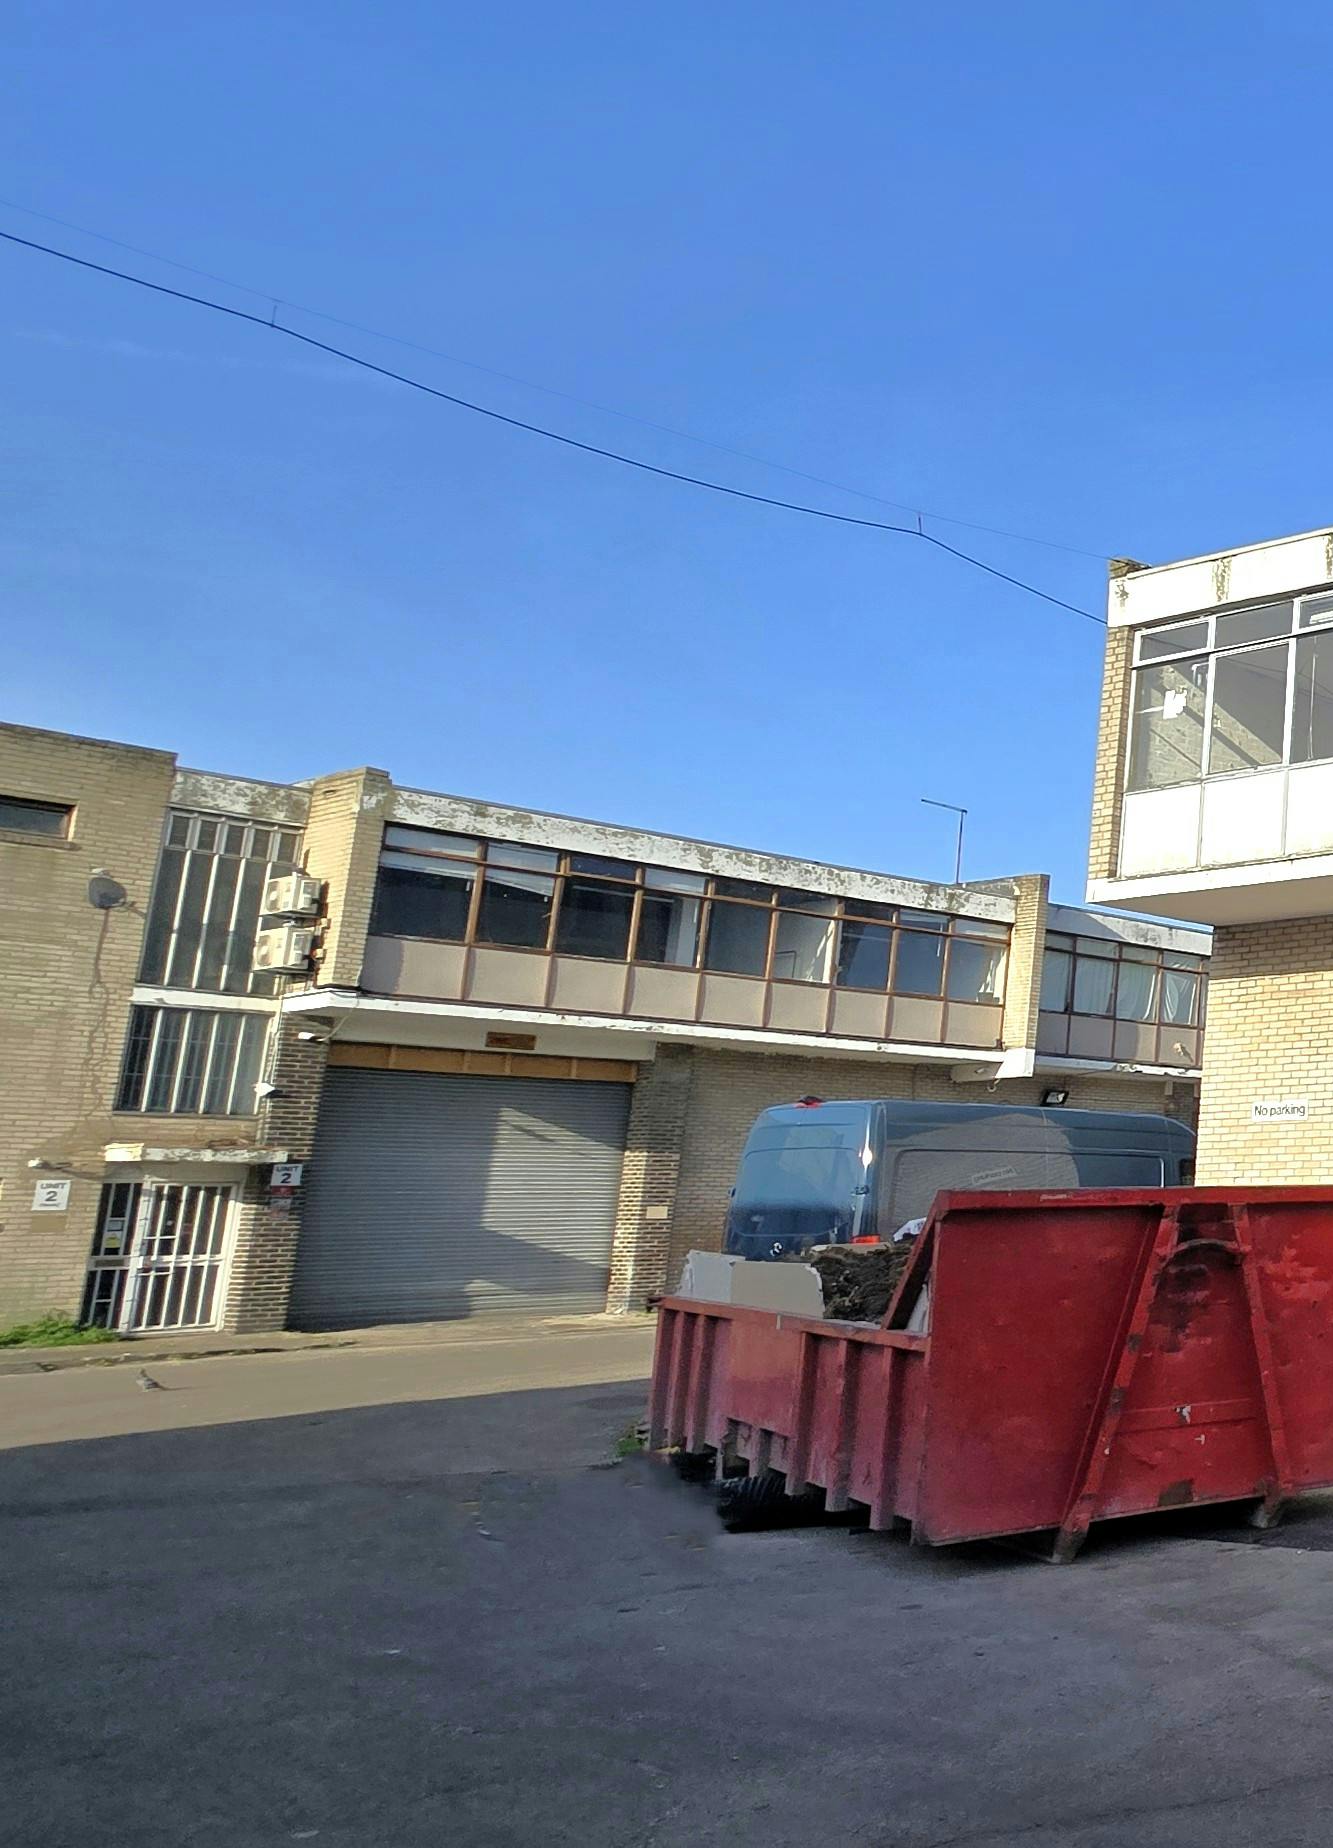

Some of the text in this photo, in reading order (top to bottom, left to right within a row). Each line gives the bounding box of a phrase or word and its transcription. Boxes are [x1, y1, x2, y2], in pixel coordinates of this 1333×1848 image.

[1254, 1103, 1306, 1117] No parking
[280, 1172, 292, 1184] 2
[44, 1190, 58, 1202] 2
